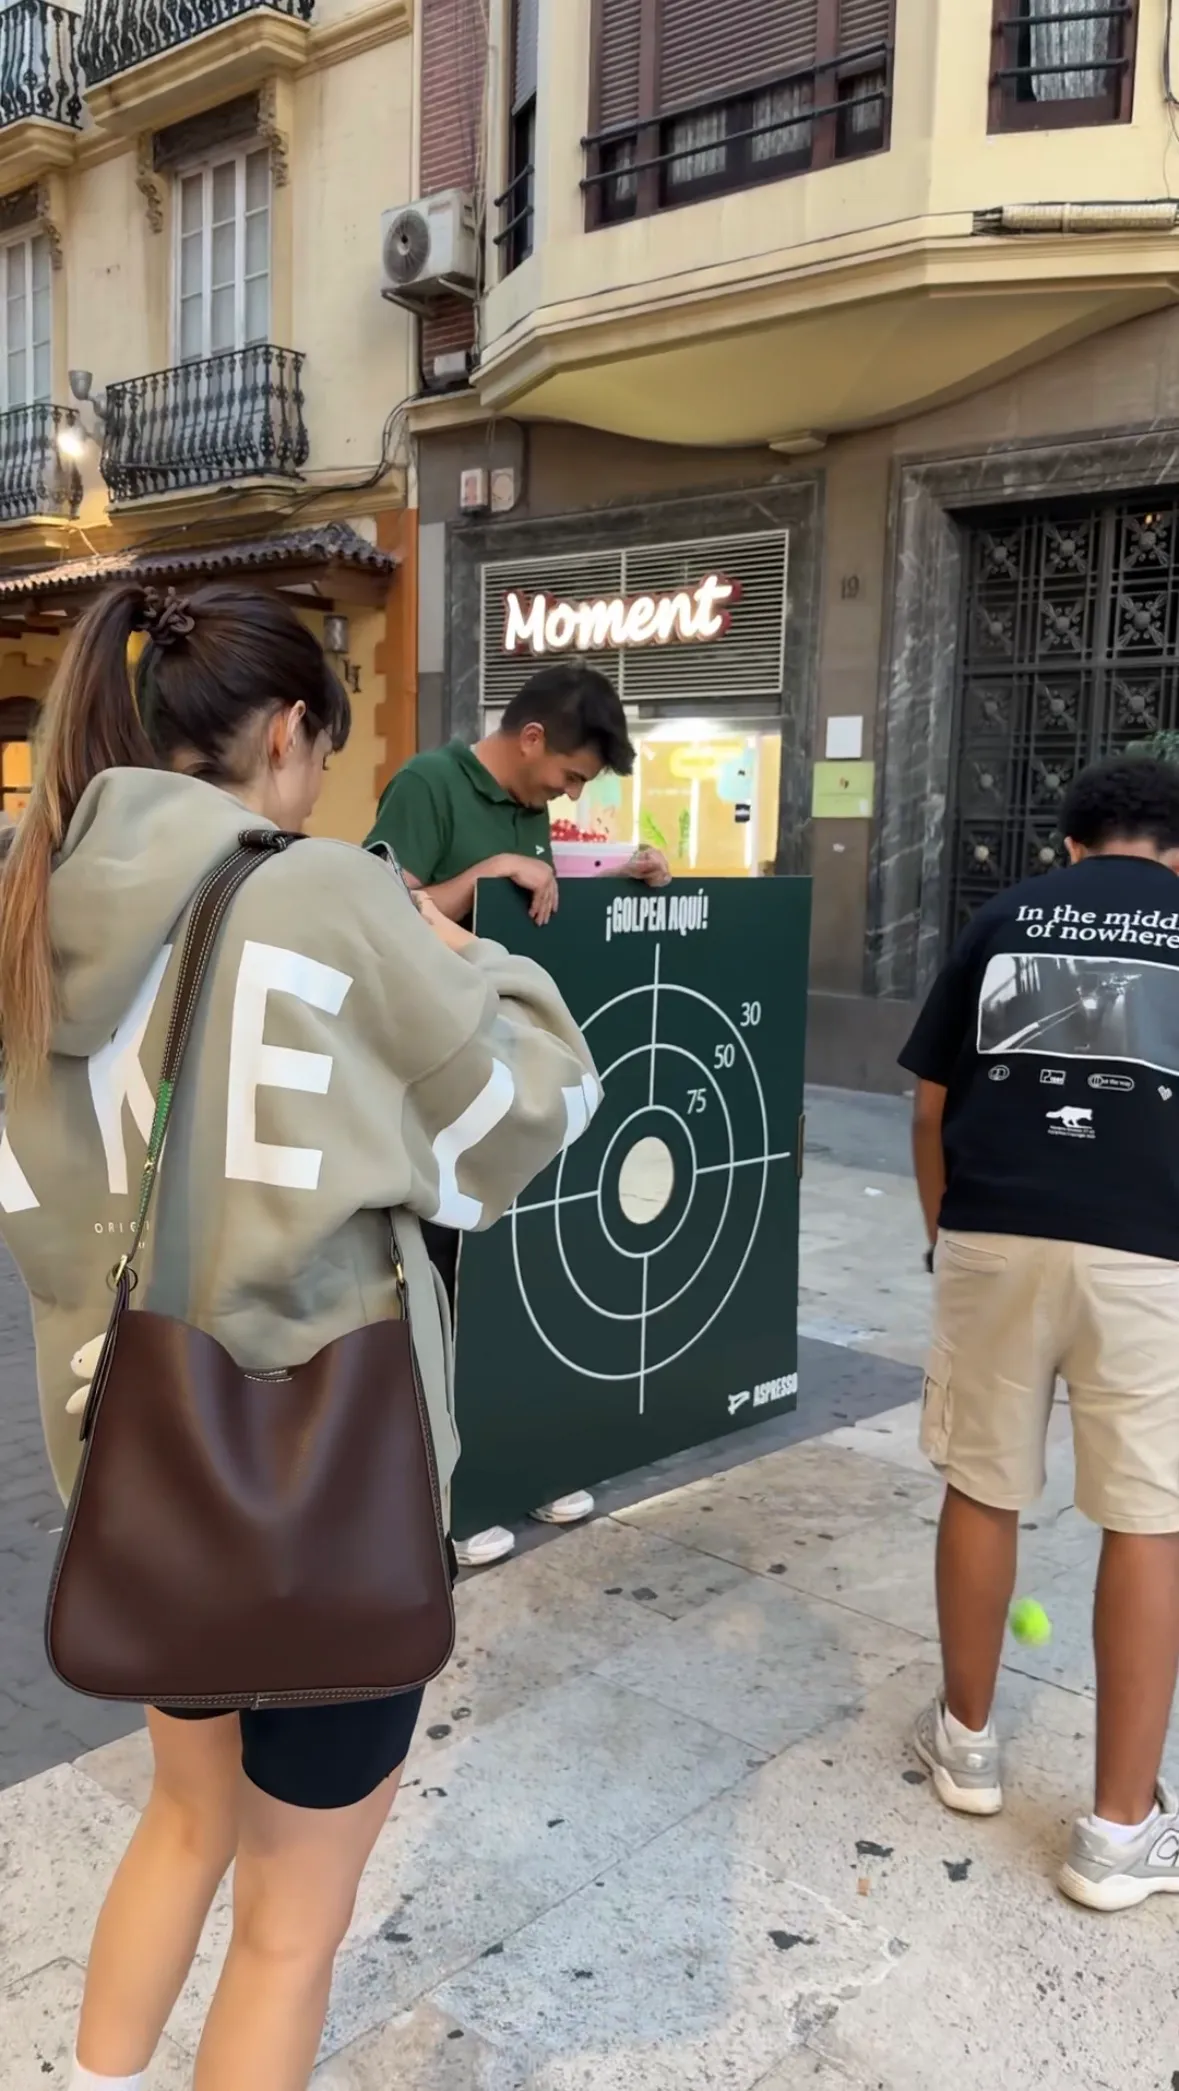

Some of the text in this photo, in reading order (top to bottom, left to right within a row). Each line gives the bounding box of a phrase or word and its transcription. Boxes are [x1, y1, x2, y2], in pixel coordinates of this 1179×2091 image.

[840, 574, 860, 601] 19
[503, 573, 738, 653] Moment
[606, 888, 709, 942] ¡GOLPEA AQUÍ!
[1015, 904, 1179, 931] In the midd
[1026, 919, 1179, 949] of nowhere
[740, 1001, 761, 1027] 30
[714, 1043, 735, 1069] 50
[687, 1088, 707, 1114] 75
[753, 1372, 798, 1407] ASPRESSO
